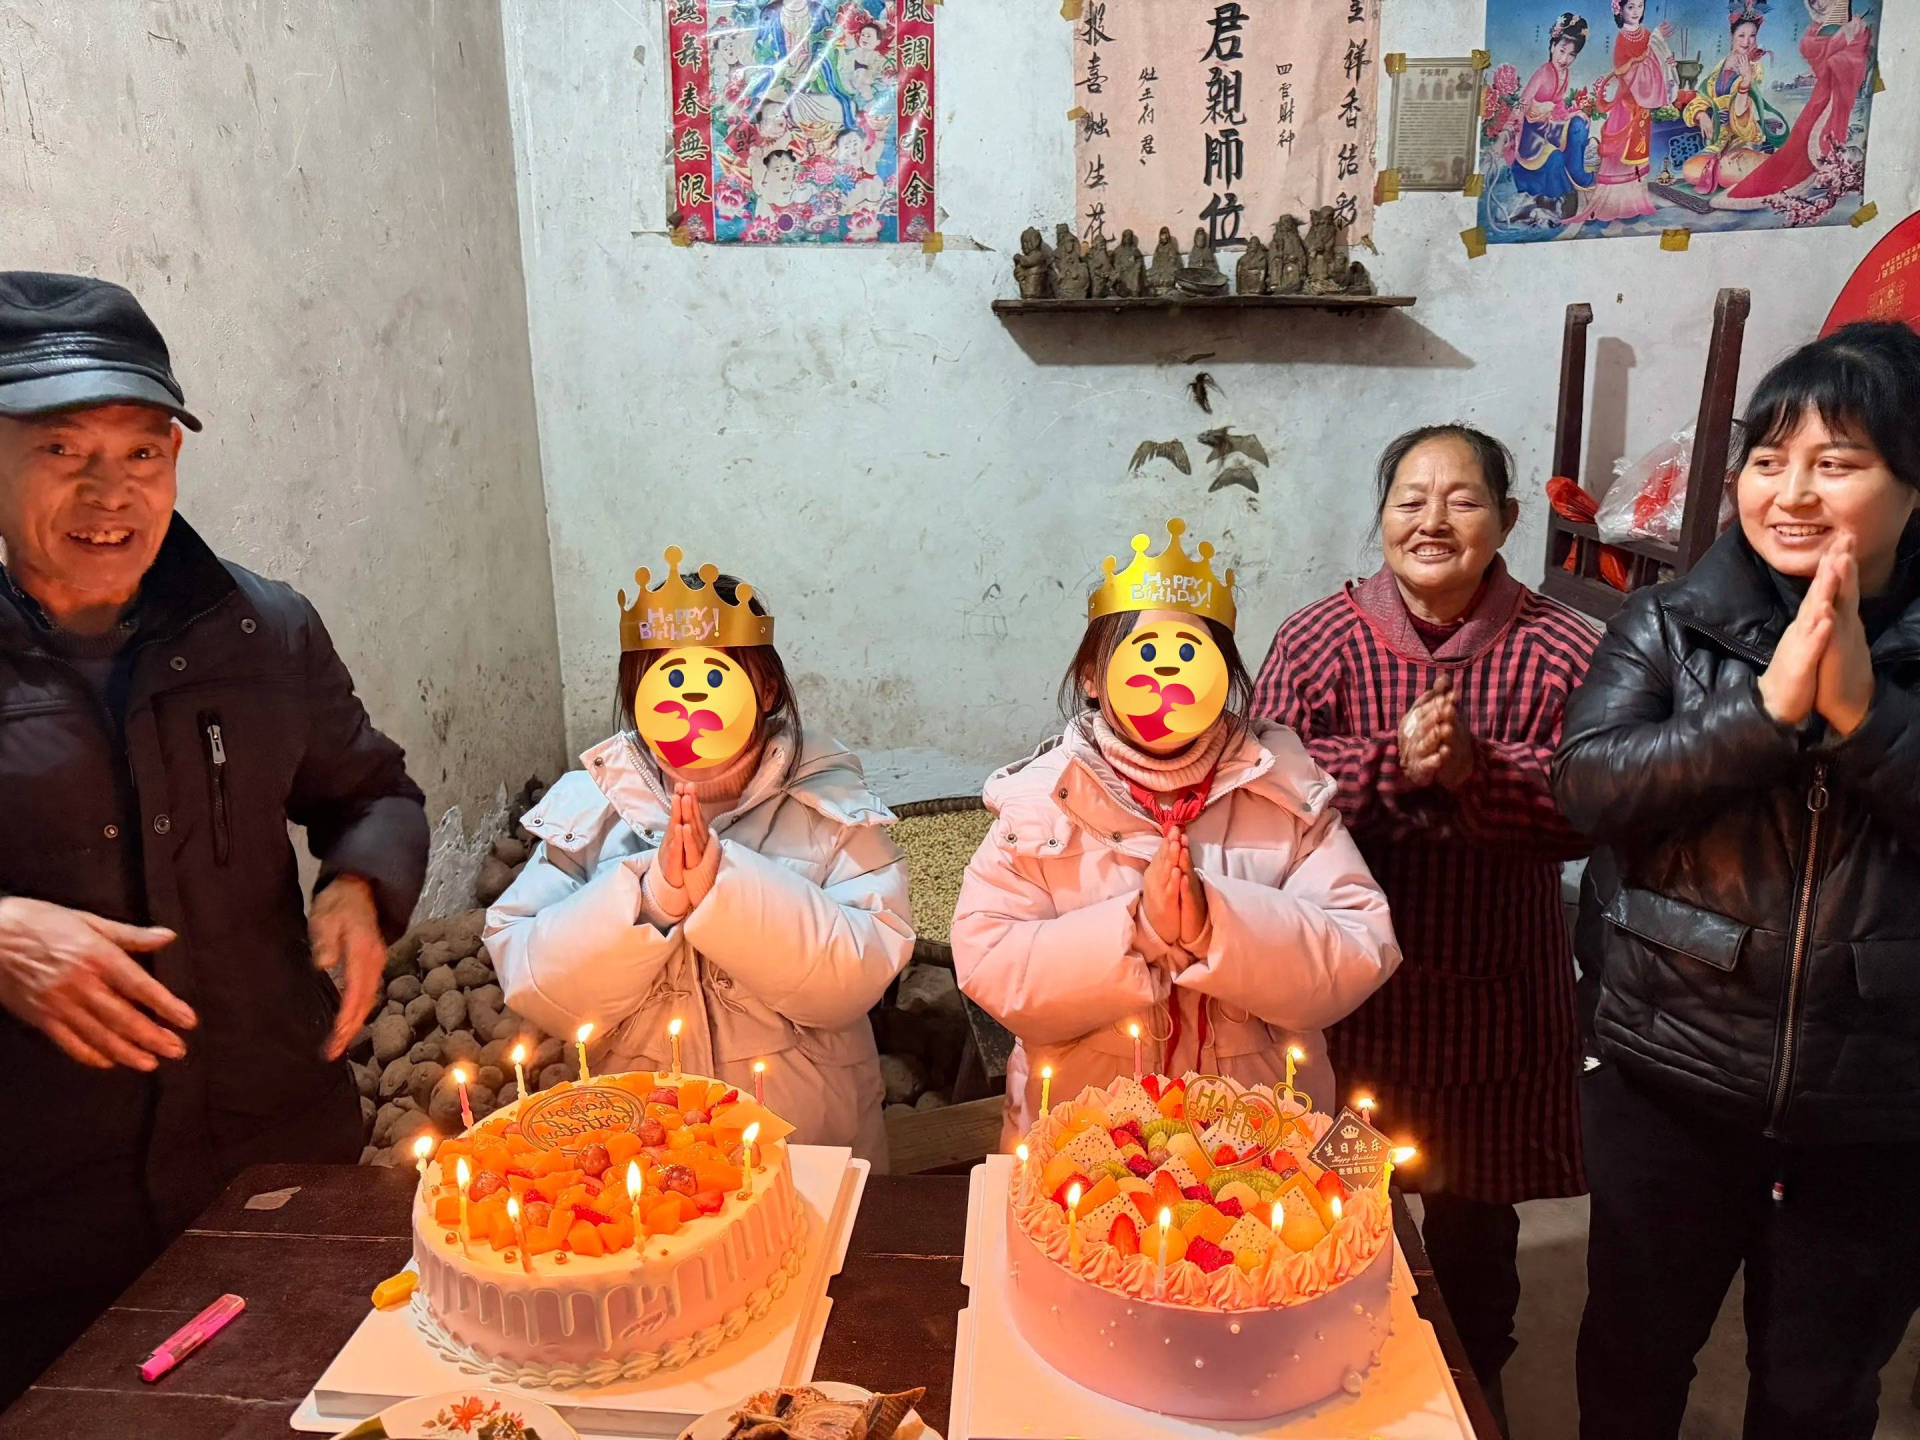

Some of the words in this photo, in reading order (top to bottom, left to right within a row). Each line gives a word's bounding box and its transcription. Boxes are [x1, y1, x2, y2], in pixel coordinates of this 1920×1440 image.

[1143, 571, 1203, 590] Happy
[647, 606, 708, 624] Happy
[1196, 1085, 1275, 1130] HAPPY
[1324, 1138, 1382, 1157] 生日快乐
